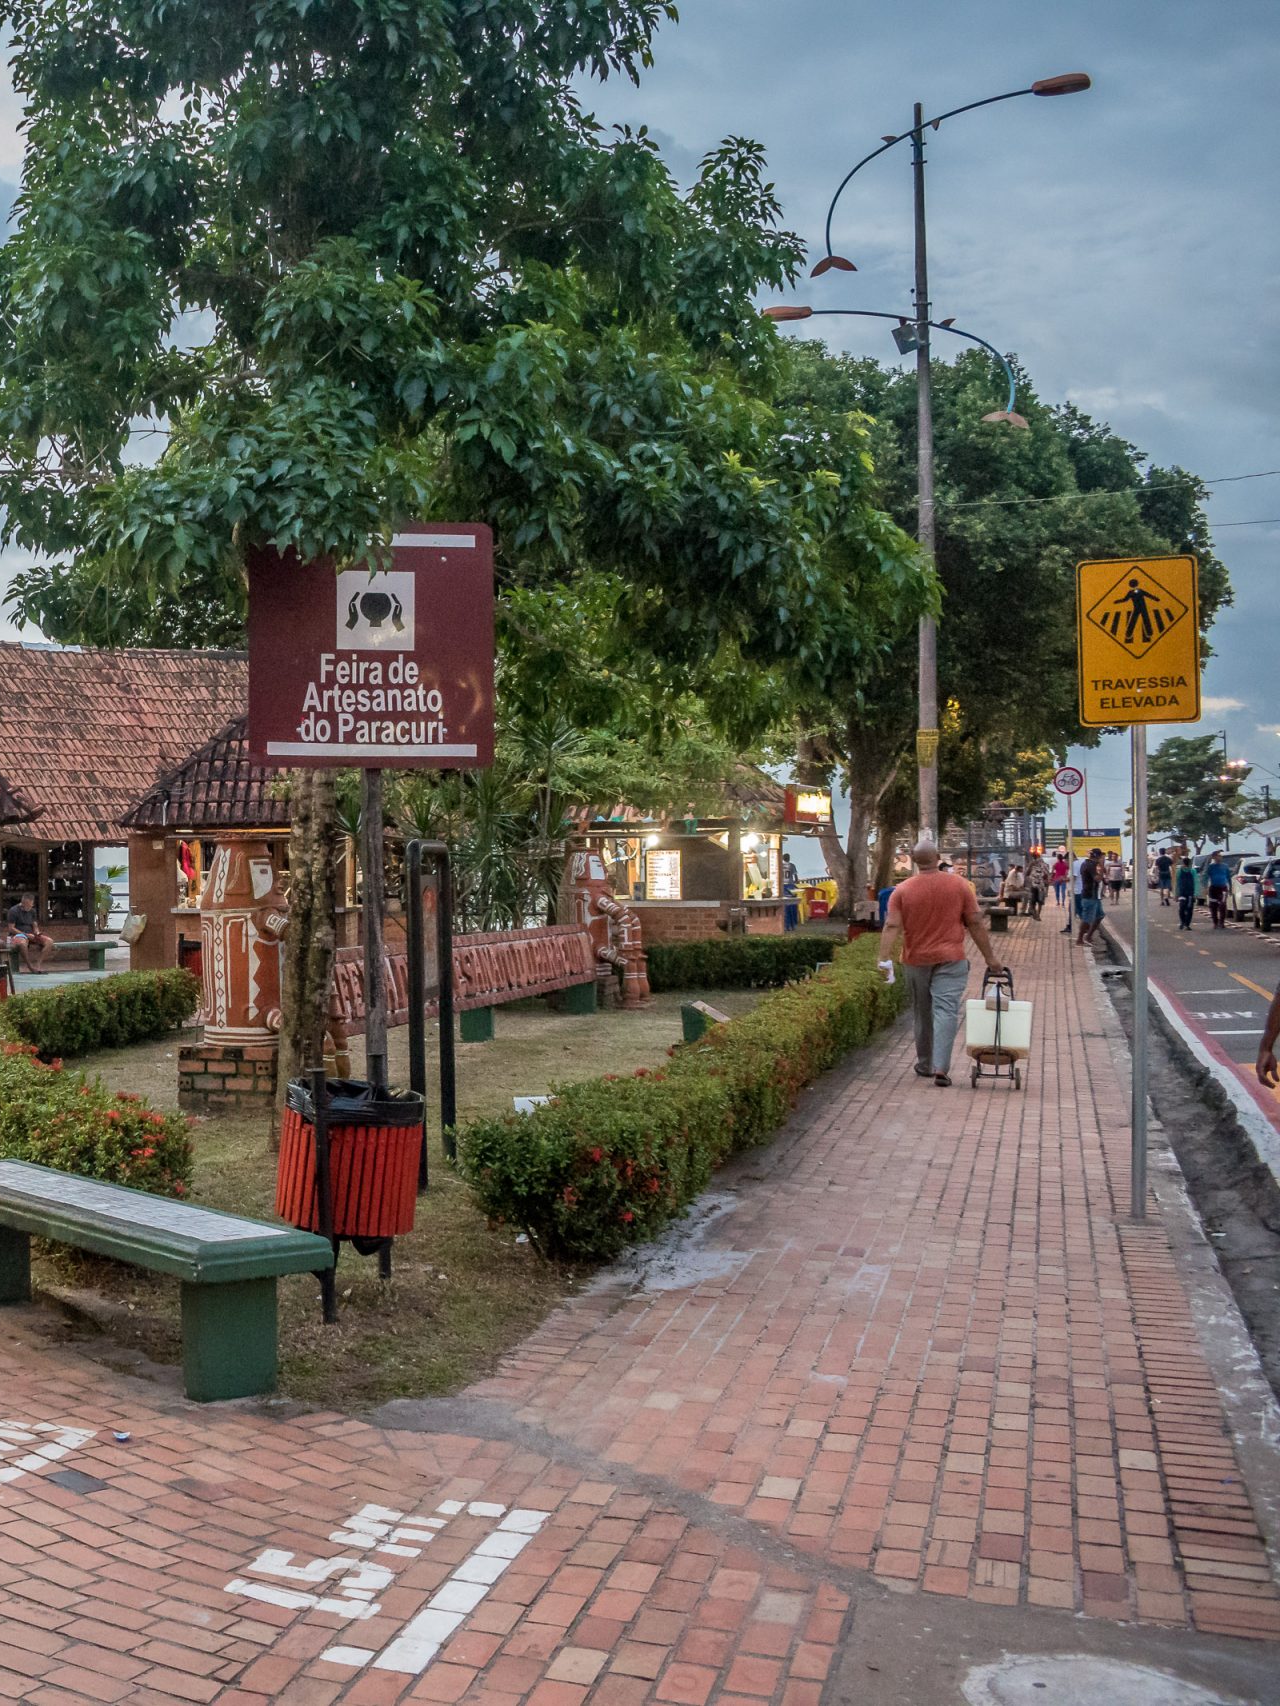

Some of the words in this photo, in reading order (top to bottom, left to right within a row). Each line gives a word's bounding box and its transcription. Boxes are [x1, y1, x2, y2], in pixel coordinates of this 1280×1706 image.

[320, 653, 382, 685] Feira
[388, 654, 419, 685] de
[1091, 676, 1187, 691] TRAVESSIA
[302, 682, 443, 713] Artesanato
[1100, 695, 1180, 709] ELEVADA
[300, 712, 331, 743] do
[338, 713, 444, 744] Paracuri
